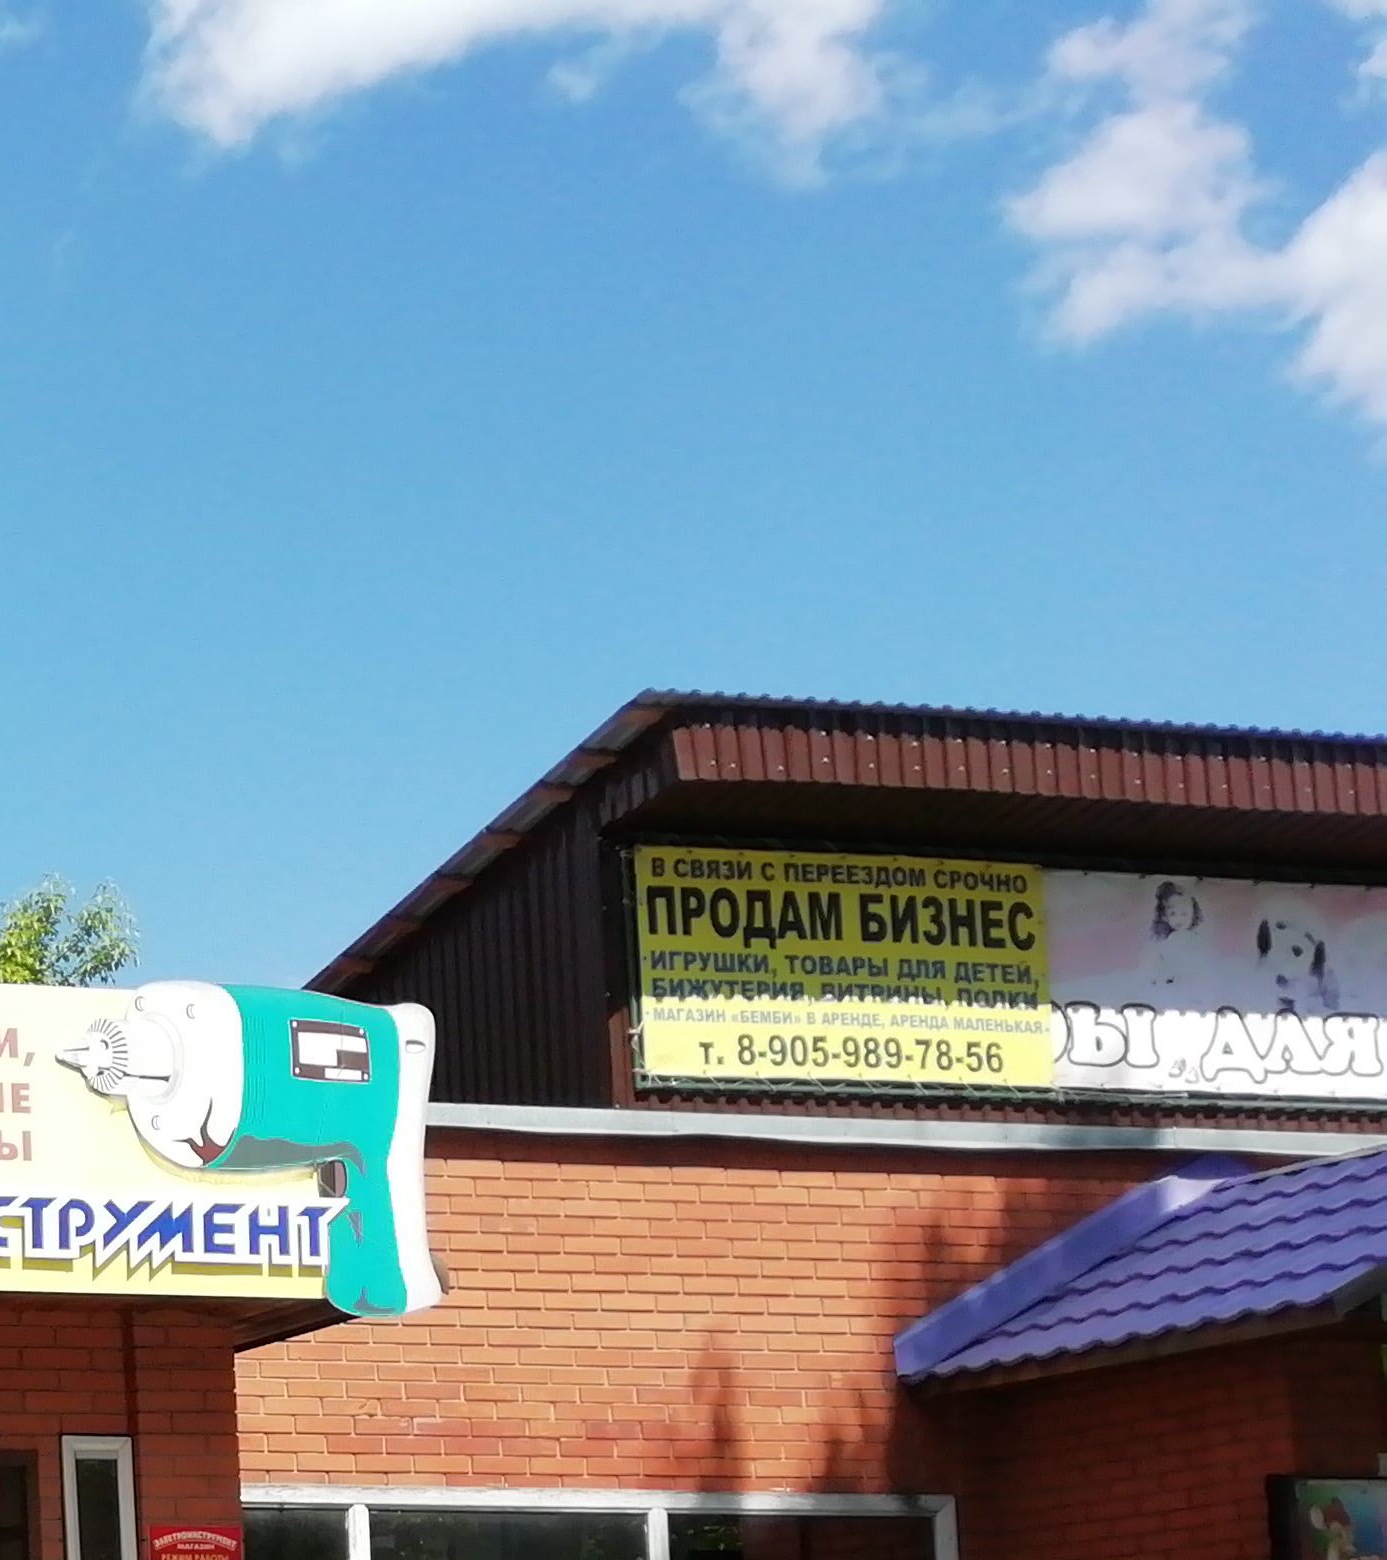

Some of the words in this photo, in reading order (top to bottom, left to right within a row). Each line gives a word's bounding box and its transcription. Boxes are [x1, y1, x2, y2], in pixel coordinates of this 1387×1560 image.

[652, 857, 665, 878] В
[673, 859, 752, 881] СВЯЗИ
[761, 862, 775, 882] С
[784, 862, 926, 889] ПЕРЕЕЗДОМ
[933, 869, 1027, 894] СРОЧНО
[647, 885, 843, 949] ПРОДАМ
[859, 892, 1035, 951] БИЗНЕС
[650, 951, 777, 978] ИГРУШКИ,
[784, 955, 888, 977] ТОВАРЫ
[897, 958, 946, 981] ДЛЯ
[954, 960, 1039, 991] ДЕТЕЙ,
[654, 1008, 726, 1023] МАГАЗИН
[732, 1010, 801, 1024] «БЕМБИ»
[806, 1012, 816, 1025] В
[822, 1012, 885, 1029] АРЕНДЕ,
[890, 1014, 949, 1031] АРЕНДА
[954, 1017, 1043, 1034] МАЛЕНЬКАЯ
[738, 1033, 1004, 1073] 8-905-989-78-56
[1200, 1005, 1383, 1083] ДЛЯ
